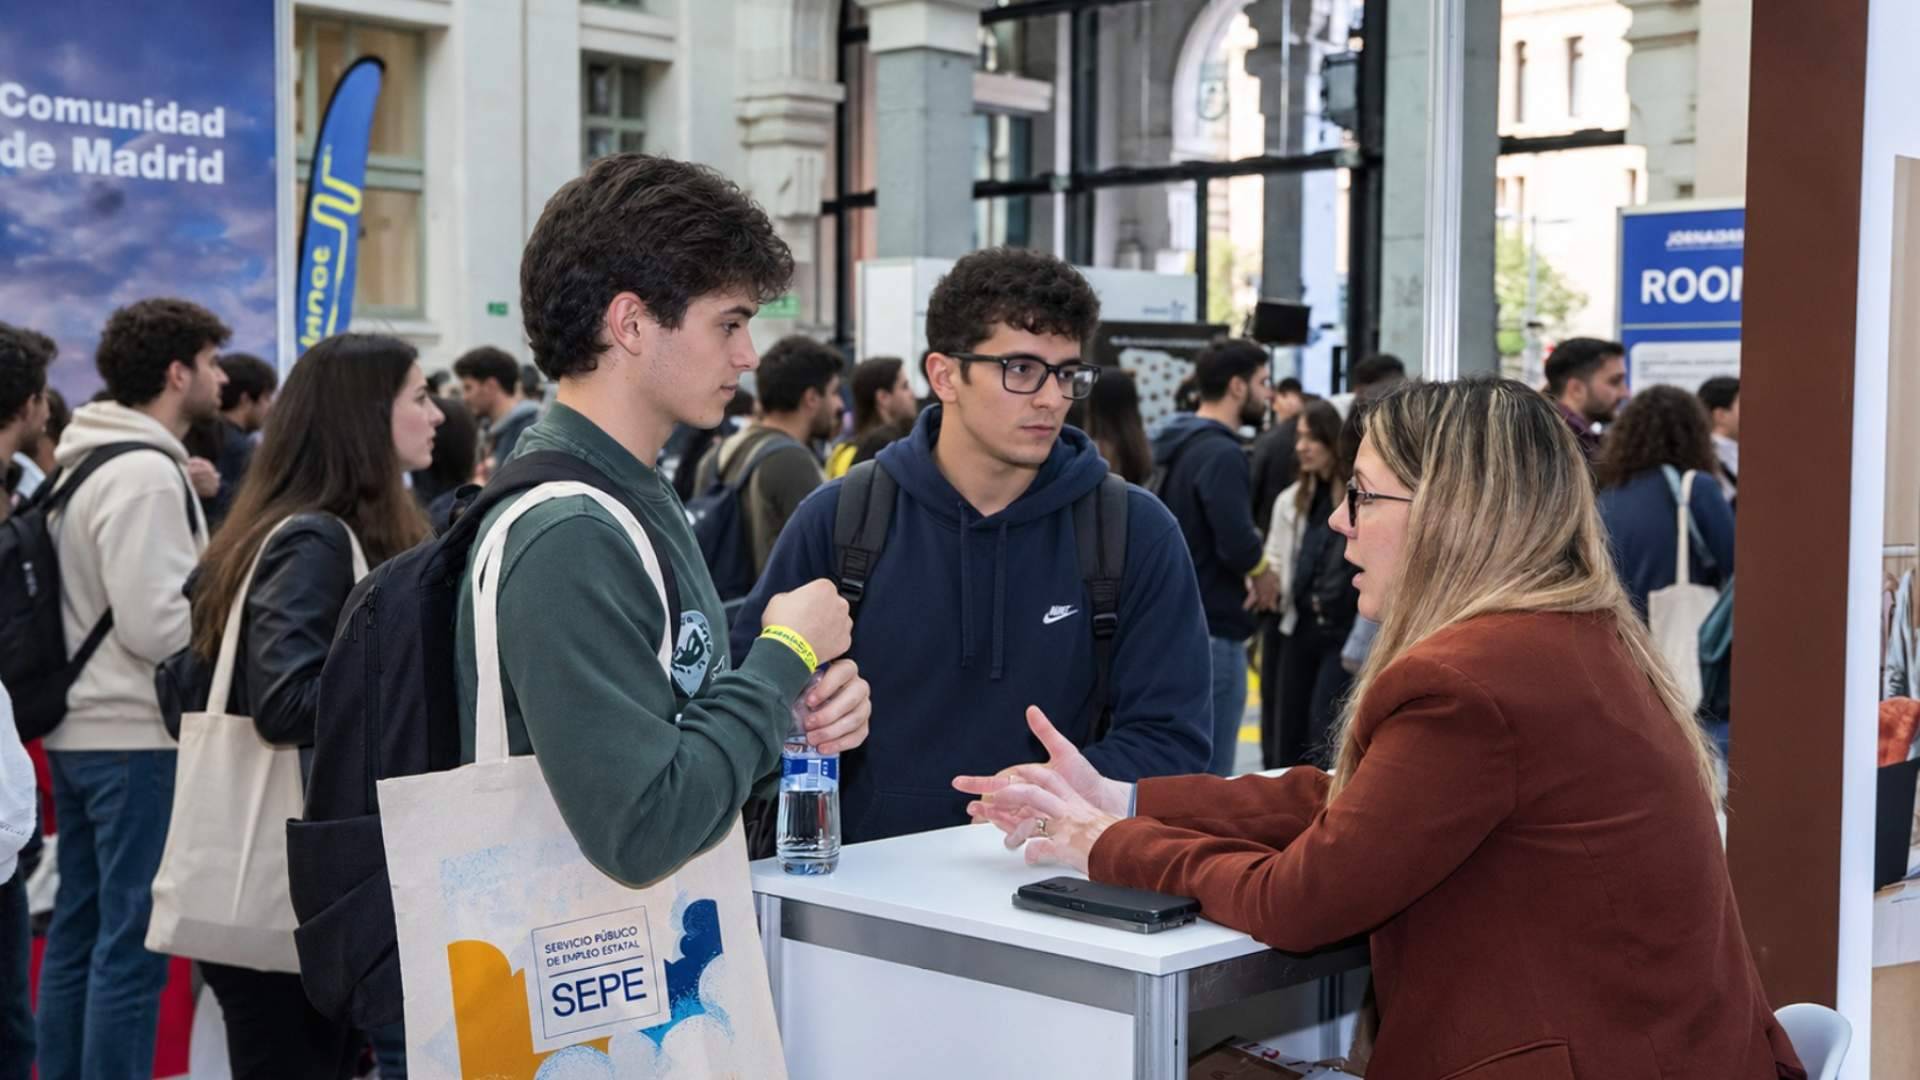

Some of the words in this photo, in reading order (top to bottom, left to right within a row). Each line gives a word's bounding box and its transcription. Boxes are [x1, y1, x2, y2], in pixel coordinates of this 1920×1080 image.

[0, 82, 225, 138] Comunidad
[0, 130, 56, 170] de
[72, 136, 225, 184] Madrid
[545, 935, 592, 954] SERVICIO
[546, 957, 560, 967] DE
[562, 948, 600, 964] EMPLEO
[602, 940, 640, 956] ESTATAL
[552, 967, 647, 1017] SEPE
